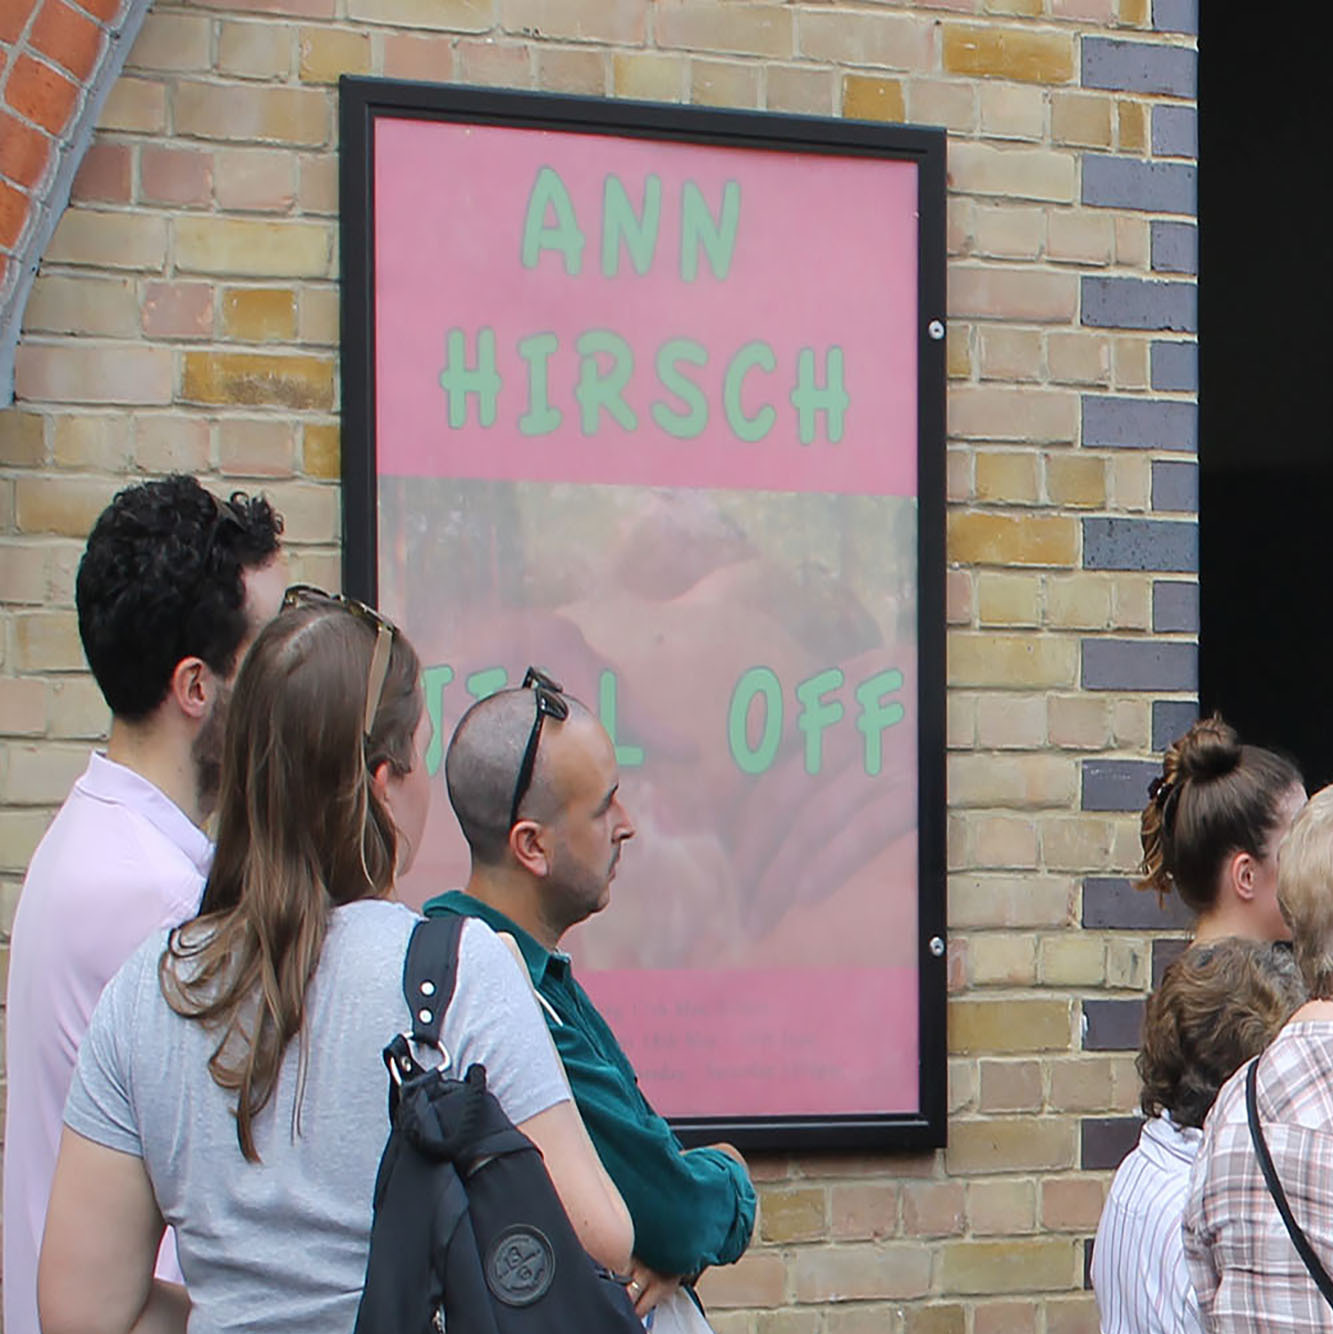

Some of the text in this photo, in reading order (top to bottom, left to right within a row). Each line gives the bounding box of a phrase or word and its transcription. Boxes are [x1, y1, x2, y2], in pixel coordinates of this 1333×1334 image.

[519, 165, 742, 284] ANN
[439, 326, 851, 446] HIRSCH
[727, 666, 905, 778] OFF
